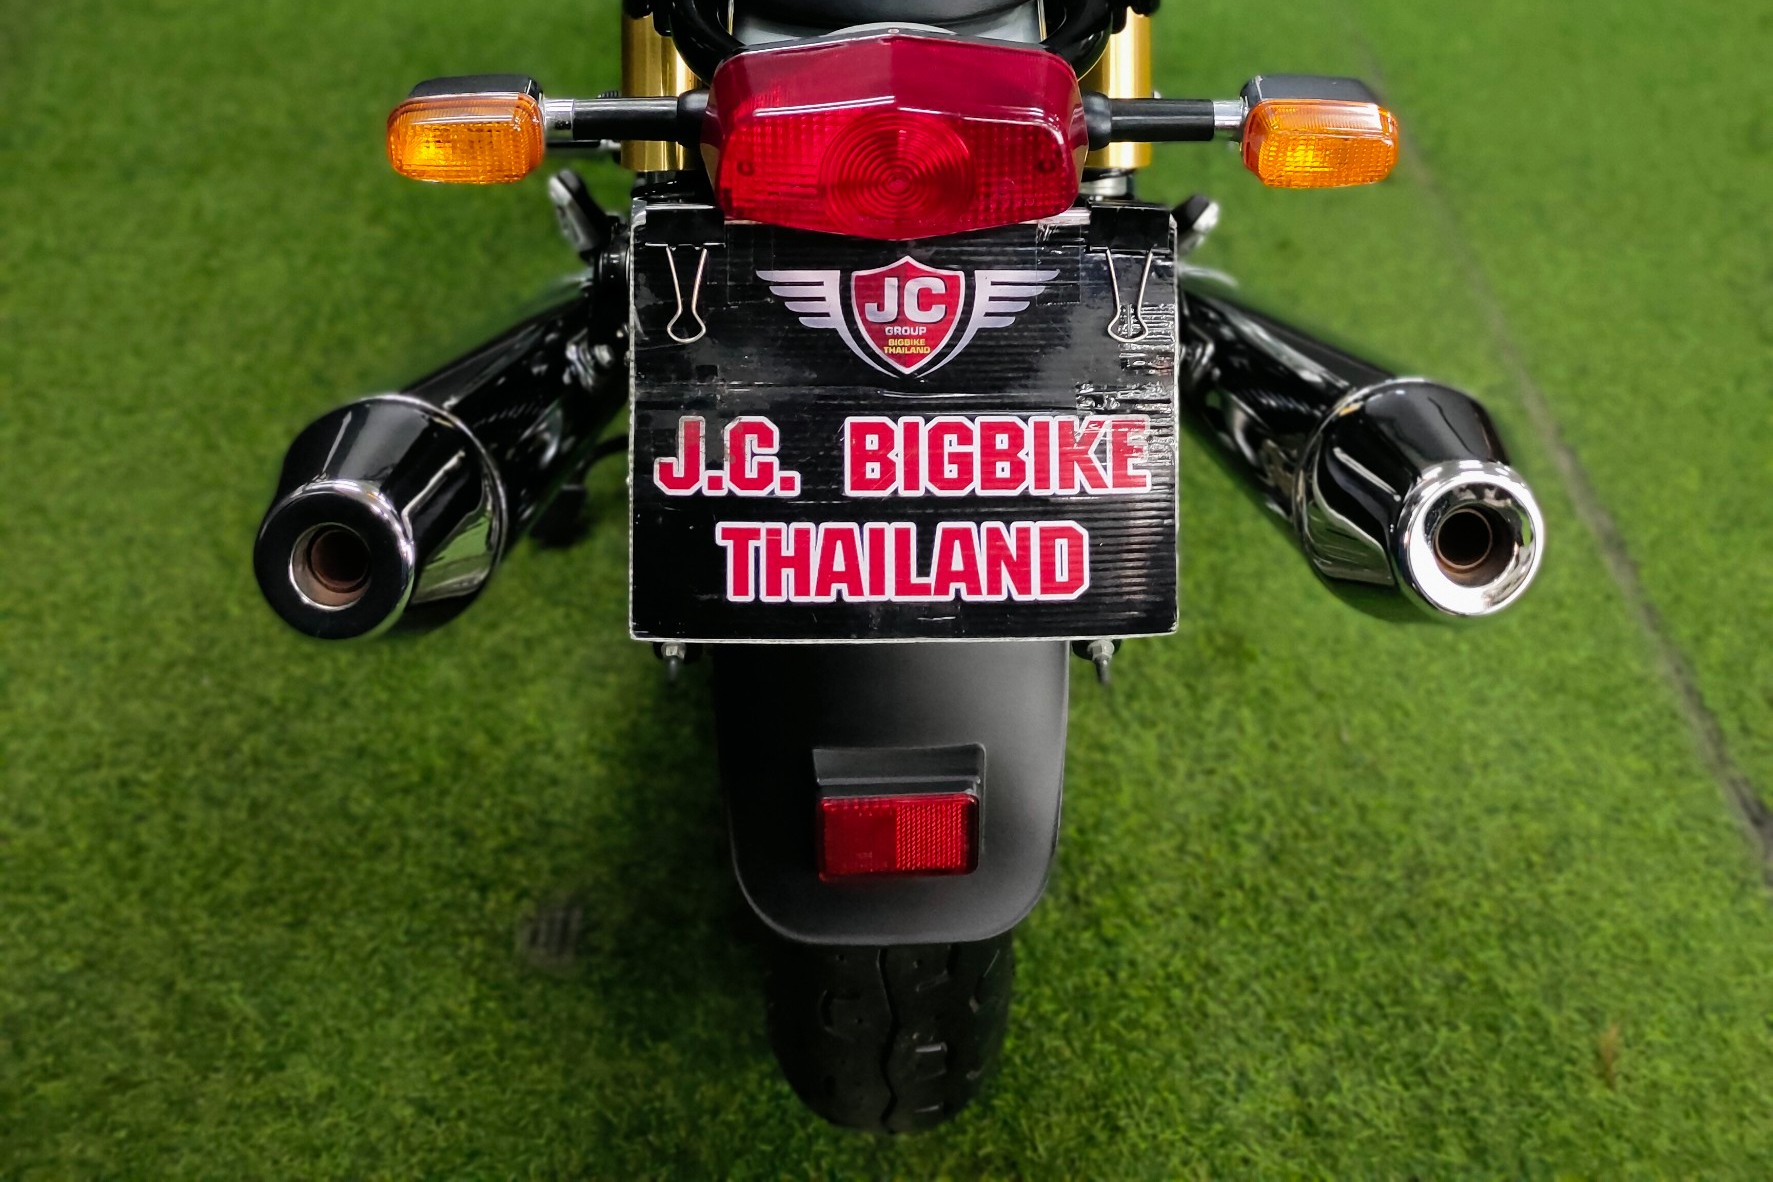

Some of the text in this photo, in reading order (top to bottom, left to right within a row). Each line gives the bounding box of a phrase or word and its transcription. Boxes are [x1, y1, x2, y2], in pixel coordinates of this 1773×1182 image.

[865, 277, 946, 323] JC
[885, 326, 927, 335] GROUP
[888, 338, 926, 346] BIGBIKE
[883, 346, 931, 354] THAILAND
[654, 415, 1153, 497] J.C. BIGBIKE
[716, 521, 1091, 602] THAILAND
